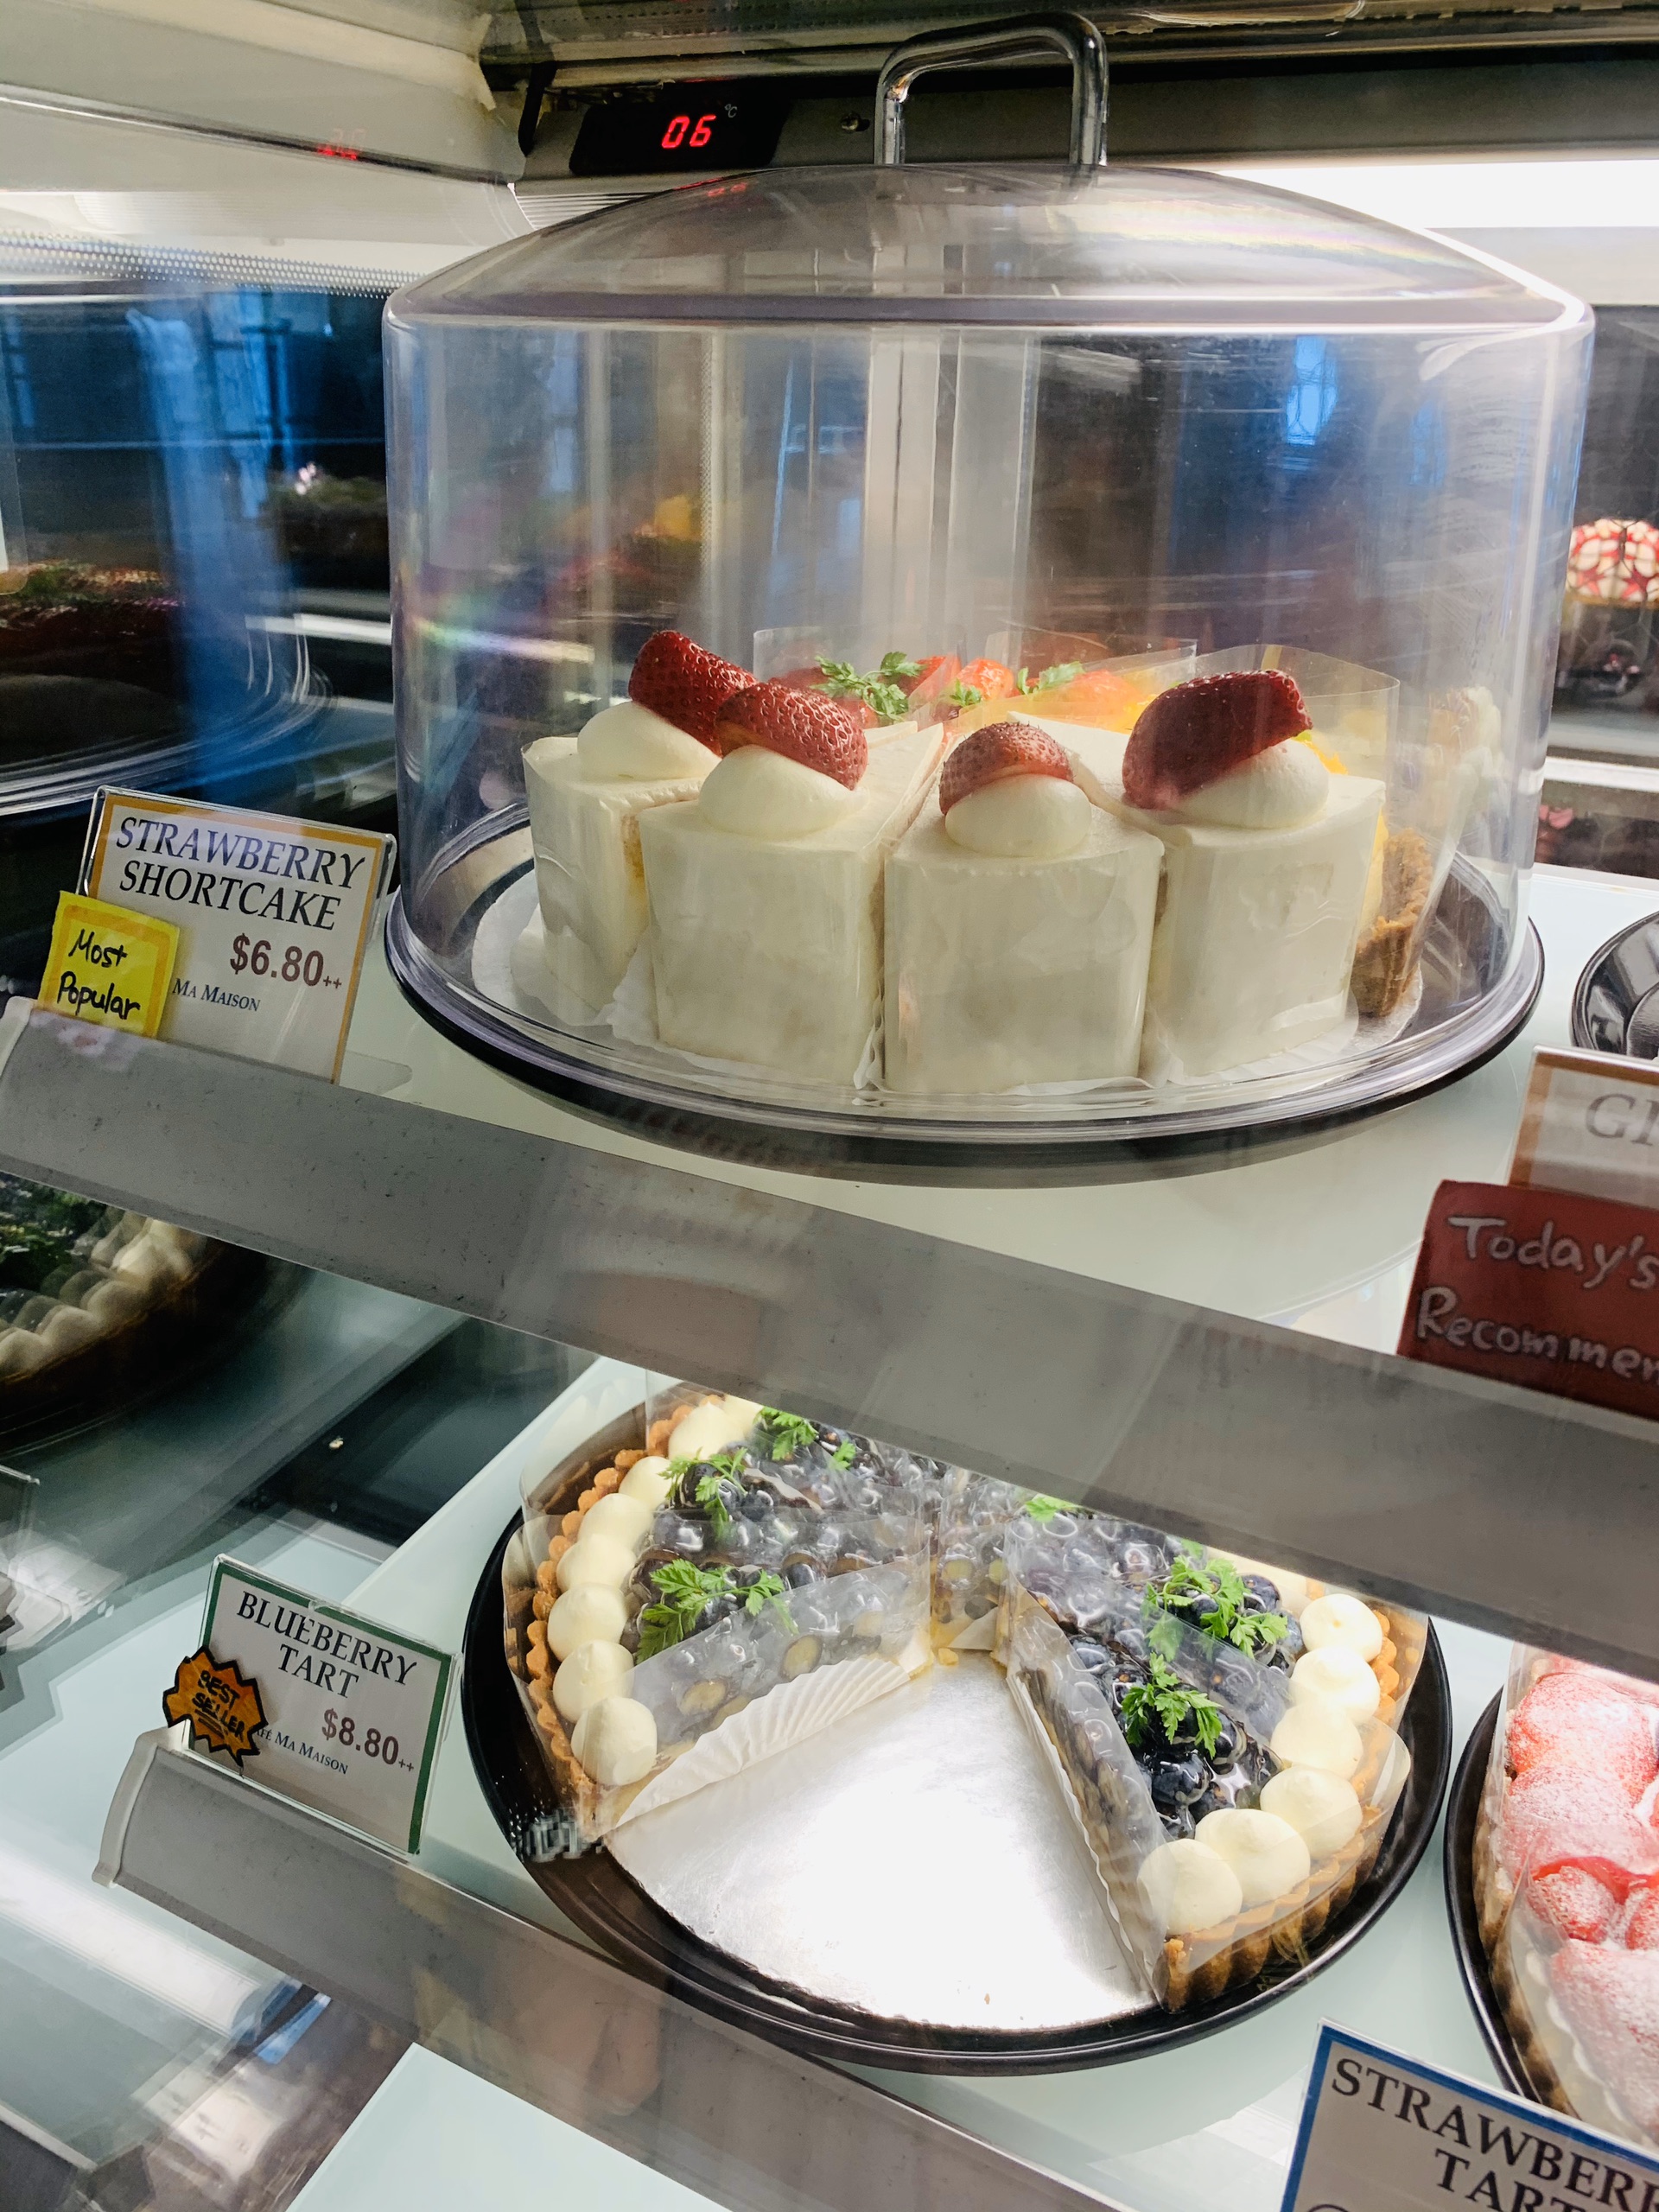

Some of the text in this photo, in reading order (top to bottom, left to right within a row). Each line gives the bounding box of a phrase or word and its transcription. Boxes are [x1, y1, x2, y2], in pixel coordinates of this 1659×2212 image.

[661, 113, 717, 149] 06
[116, 816, 365, 889] STRAWBERRY
[119, 860, 341, 931] SHORTCAKE
[67, 928, 129, 969] Most
[56, 970, 141, 1020] Popular
[1447, 1215, 1659, 1290] Today's
[236, 1591, 418, 1687] BLUEBERRY
[197, 1669, 241, 1711] BEST
[277, 1643, 359, 1700] TART
[192, 1691, 245, 1743] SELLER
